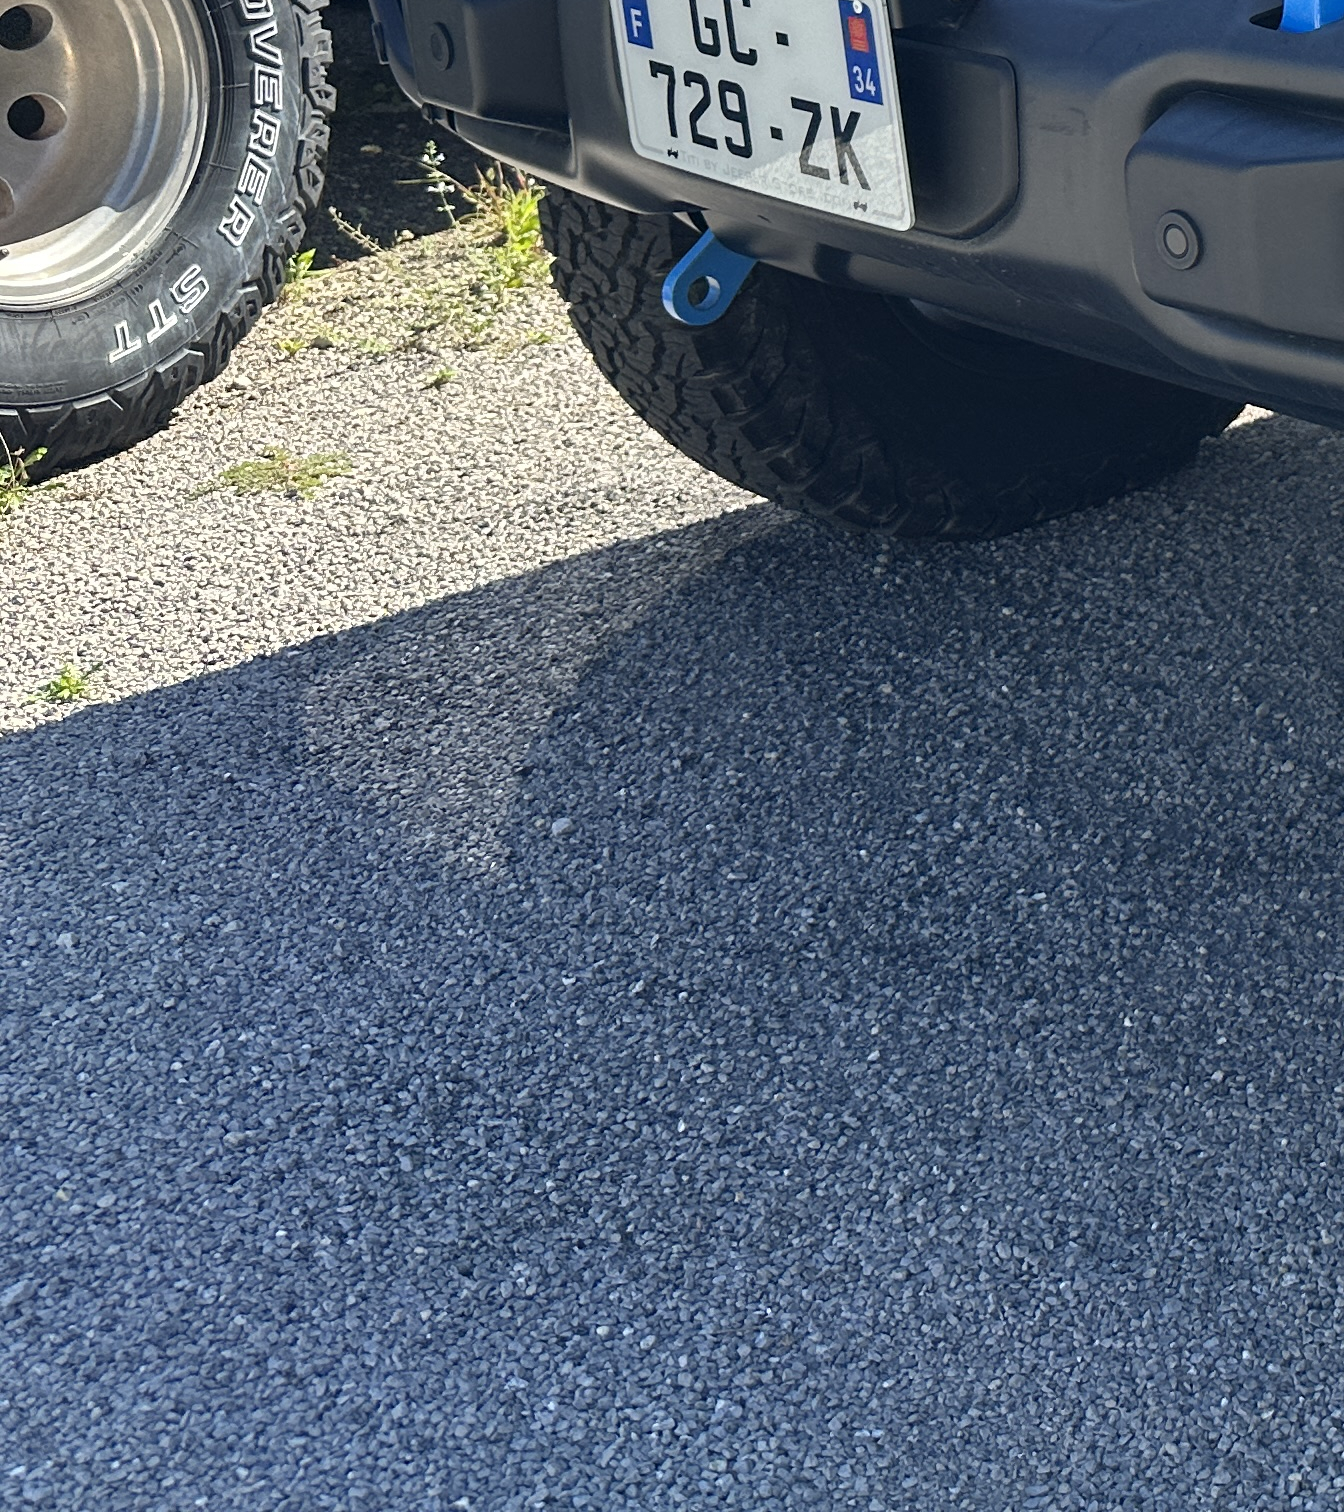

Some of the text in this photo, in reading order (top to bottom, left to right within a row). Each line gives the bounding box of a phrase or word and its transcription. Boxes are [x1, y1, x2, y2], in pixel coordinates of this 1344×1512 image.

[629, 7, 643, 38] F
[851, 64, 877, 97] 34
[108, 263, 210, 365] STT
